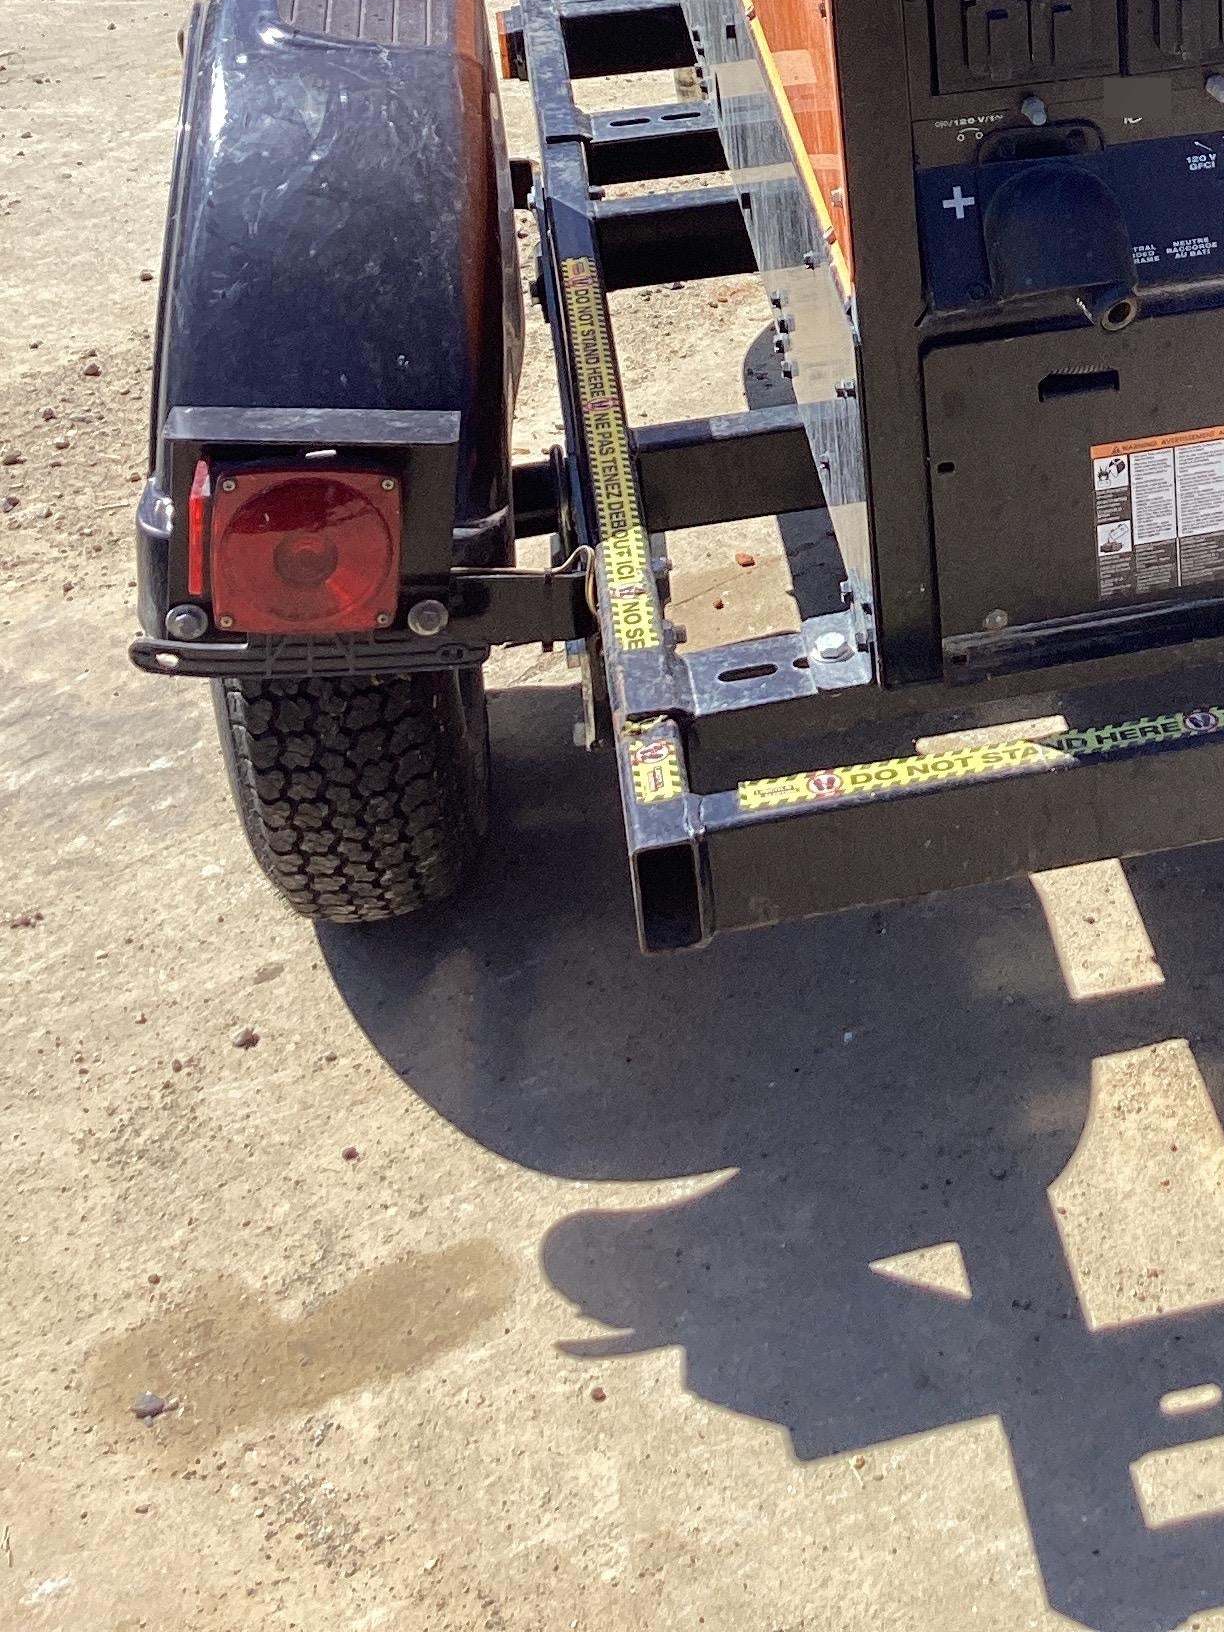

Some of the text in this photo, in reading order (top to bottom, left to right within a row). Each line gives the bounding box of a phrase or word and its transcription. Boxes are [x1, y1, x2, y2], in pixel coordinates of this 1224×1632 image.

[1185, 153, 1217, 165] 120 V
[1188, 161, 1216, 172] GFCI
[1173, 236, 1210, 248] NEUTRE
[572, 288, 589, 303] DO
[576, 305, 593, 327] NOT
[580, 328, 600, 366] STAND
[585, 366, 605, 398] HERE
[593, 412, 636, 581] NE PAS TENEZ DEBOUT ICI
[622, 602, 646, 649] NO SE
[850, 768, 901, 786] DO
[905, 756, 976, 776] NOT
[1092, 721, 1183, 746] HERE
